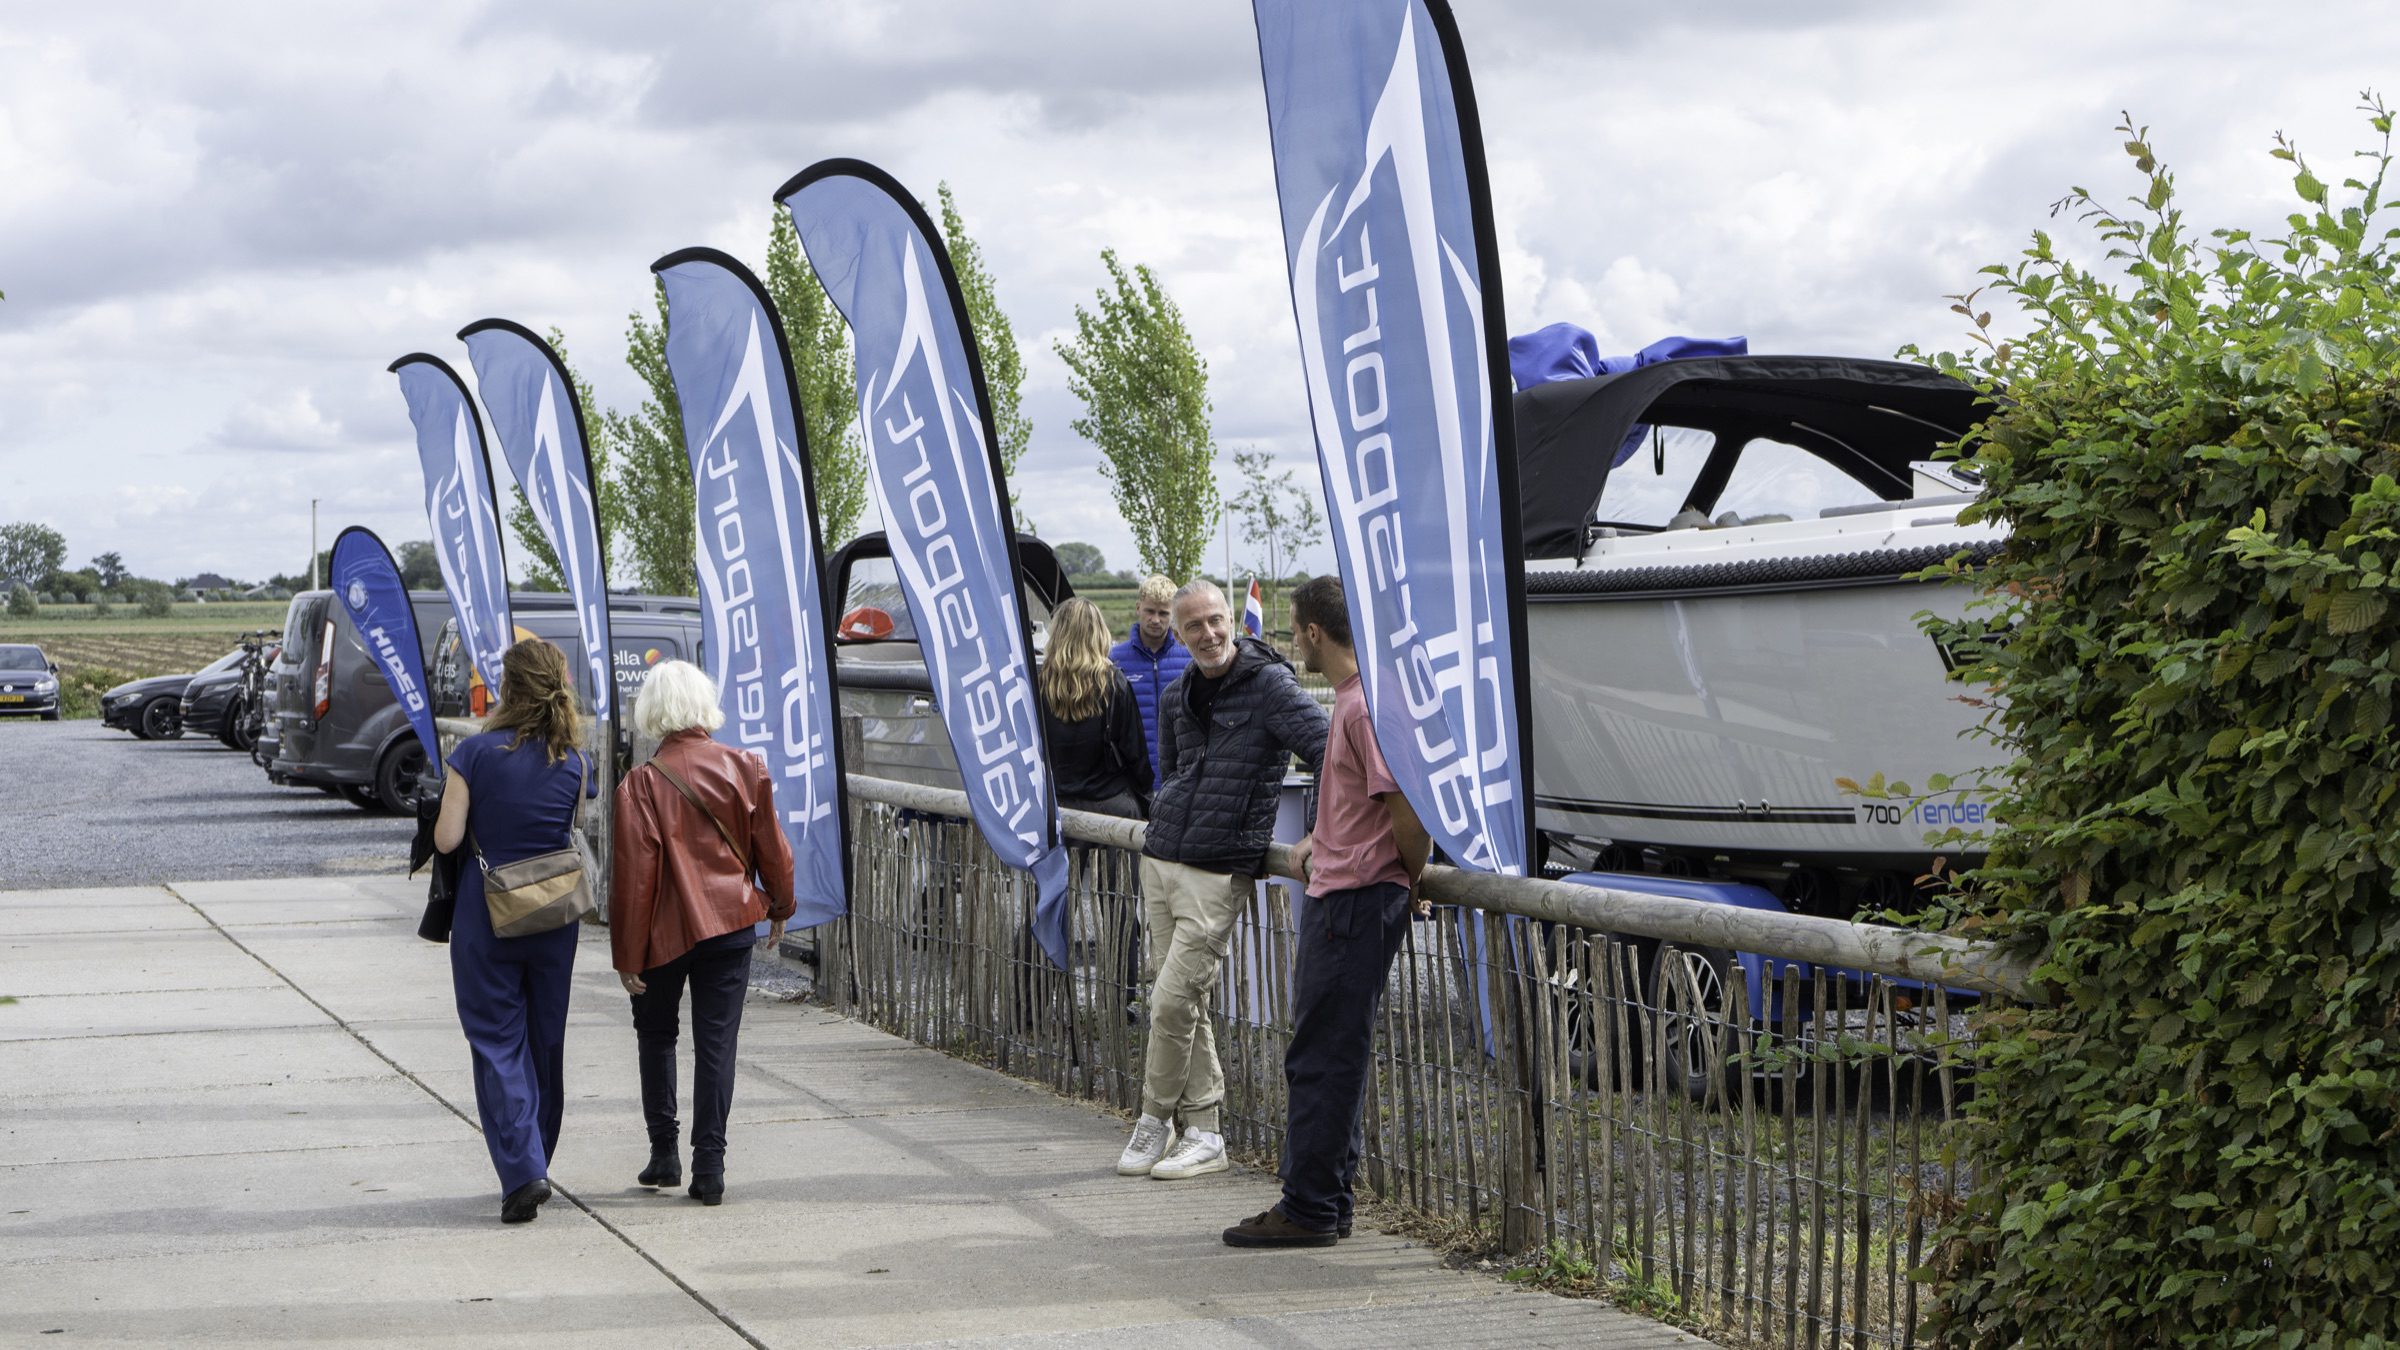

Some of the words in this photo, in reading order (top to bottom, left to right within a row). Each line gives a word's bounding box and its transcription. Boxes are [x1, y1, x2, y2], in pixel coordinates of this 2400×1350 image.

[613, 650, 640, 665] ella
[1862, 804, 1901, 825] 700
[1908, 799, 1987, 825] Tender
